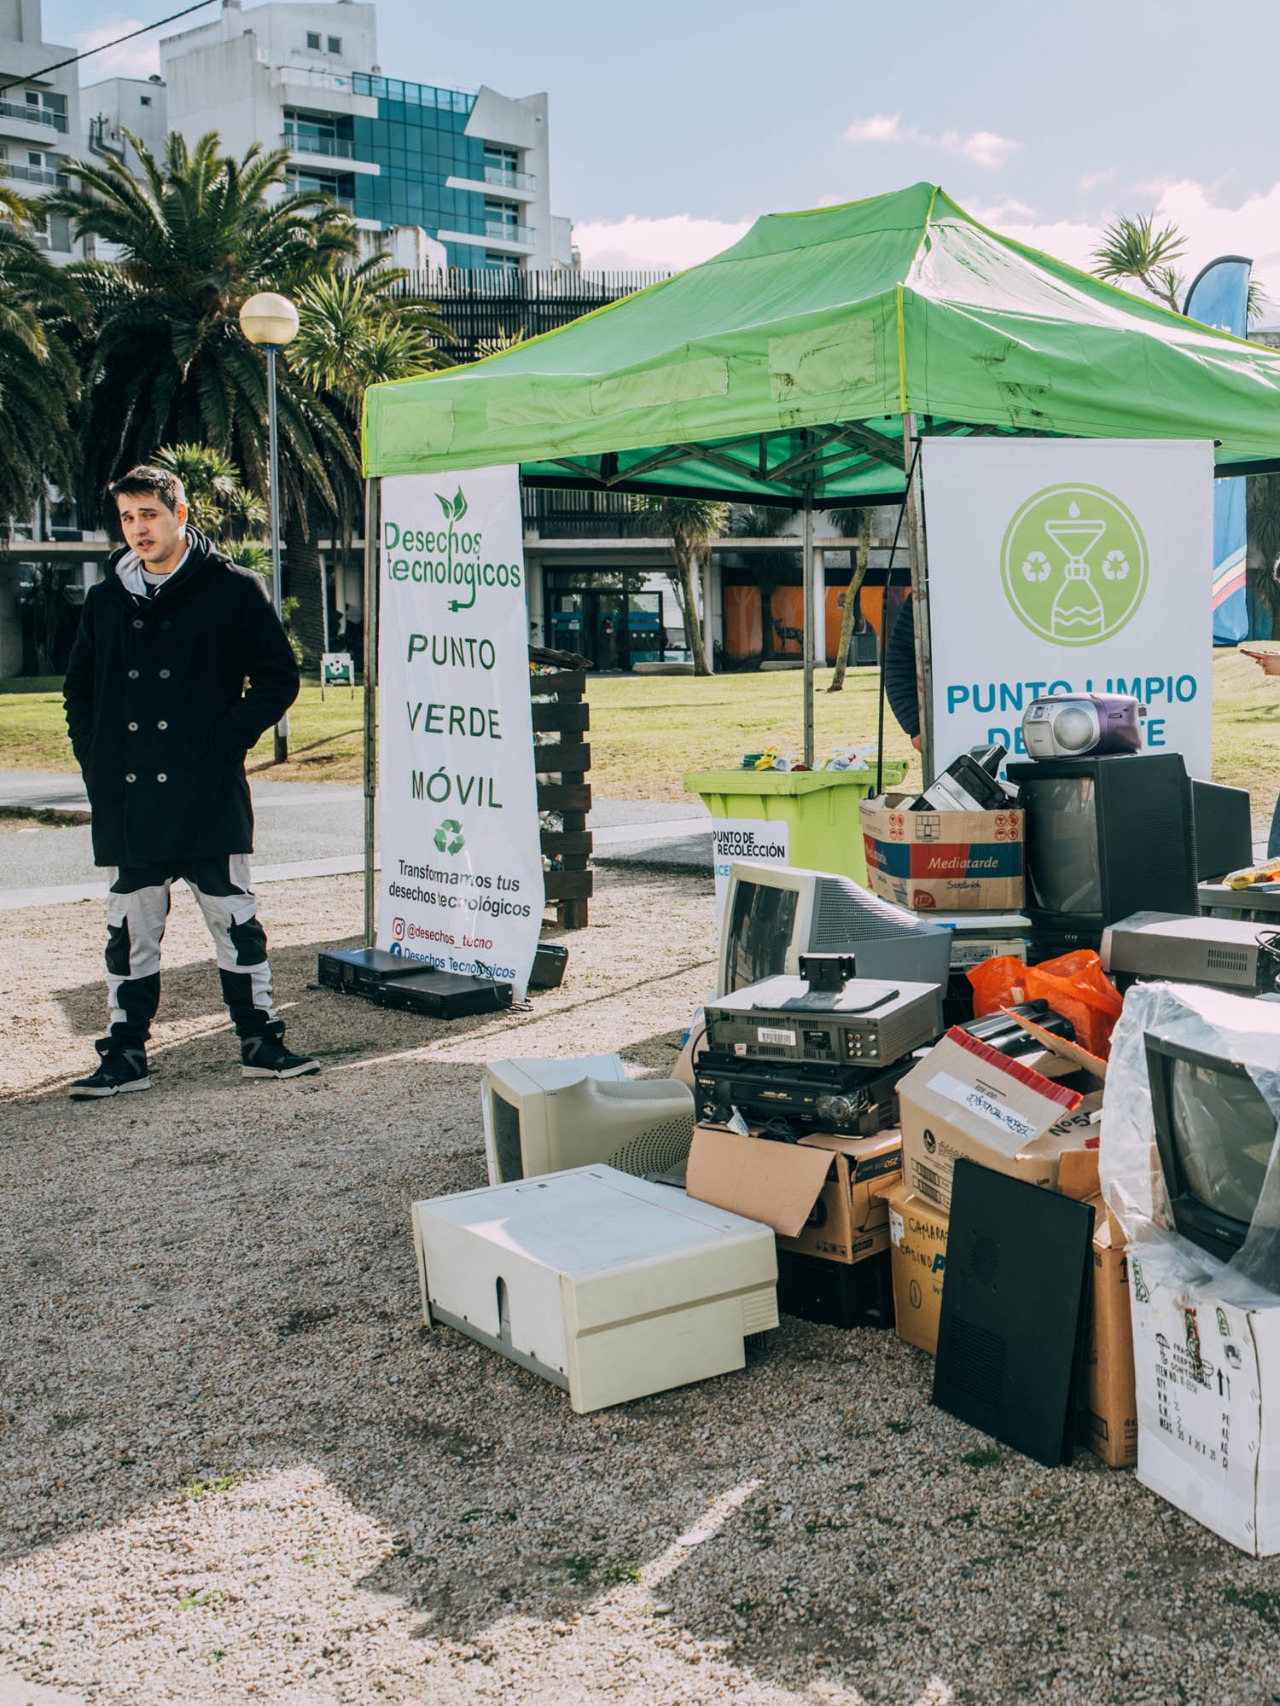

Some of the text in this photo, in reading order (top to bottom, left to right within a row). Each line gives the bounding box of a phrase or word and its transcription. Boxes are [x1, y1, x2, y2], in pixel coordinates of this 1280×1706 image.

[384, 521, 483, 555] Desechos
[407, 633, 496, 670] PUNTO
[406, 701, 503, 739] VERDE
[411, 766, 503, 809] MÓVIL
[717, 841, 786, 858] RECOLECCIÓN
[743, 832, 755, 844] DE
[398, 859, 520, 892] Transformamos tus
[927, 857, 999, 870] Mediatarde
[389, 882, 436, 906] desechos
[407, 923, 493, 950] @desechos_tecno
[404, 947, 446, 969] Desechos
